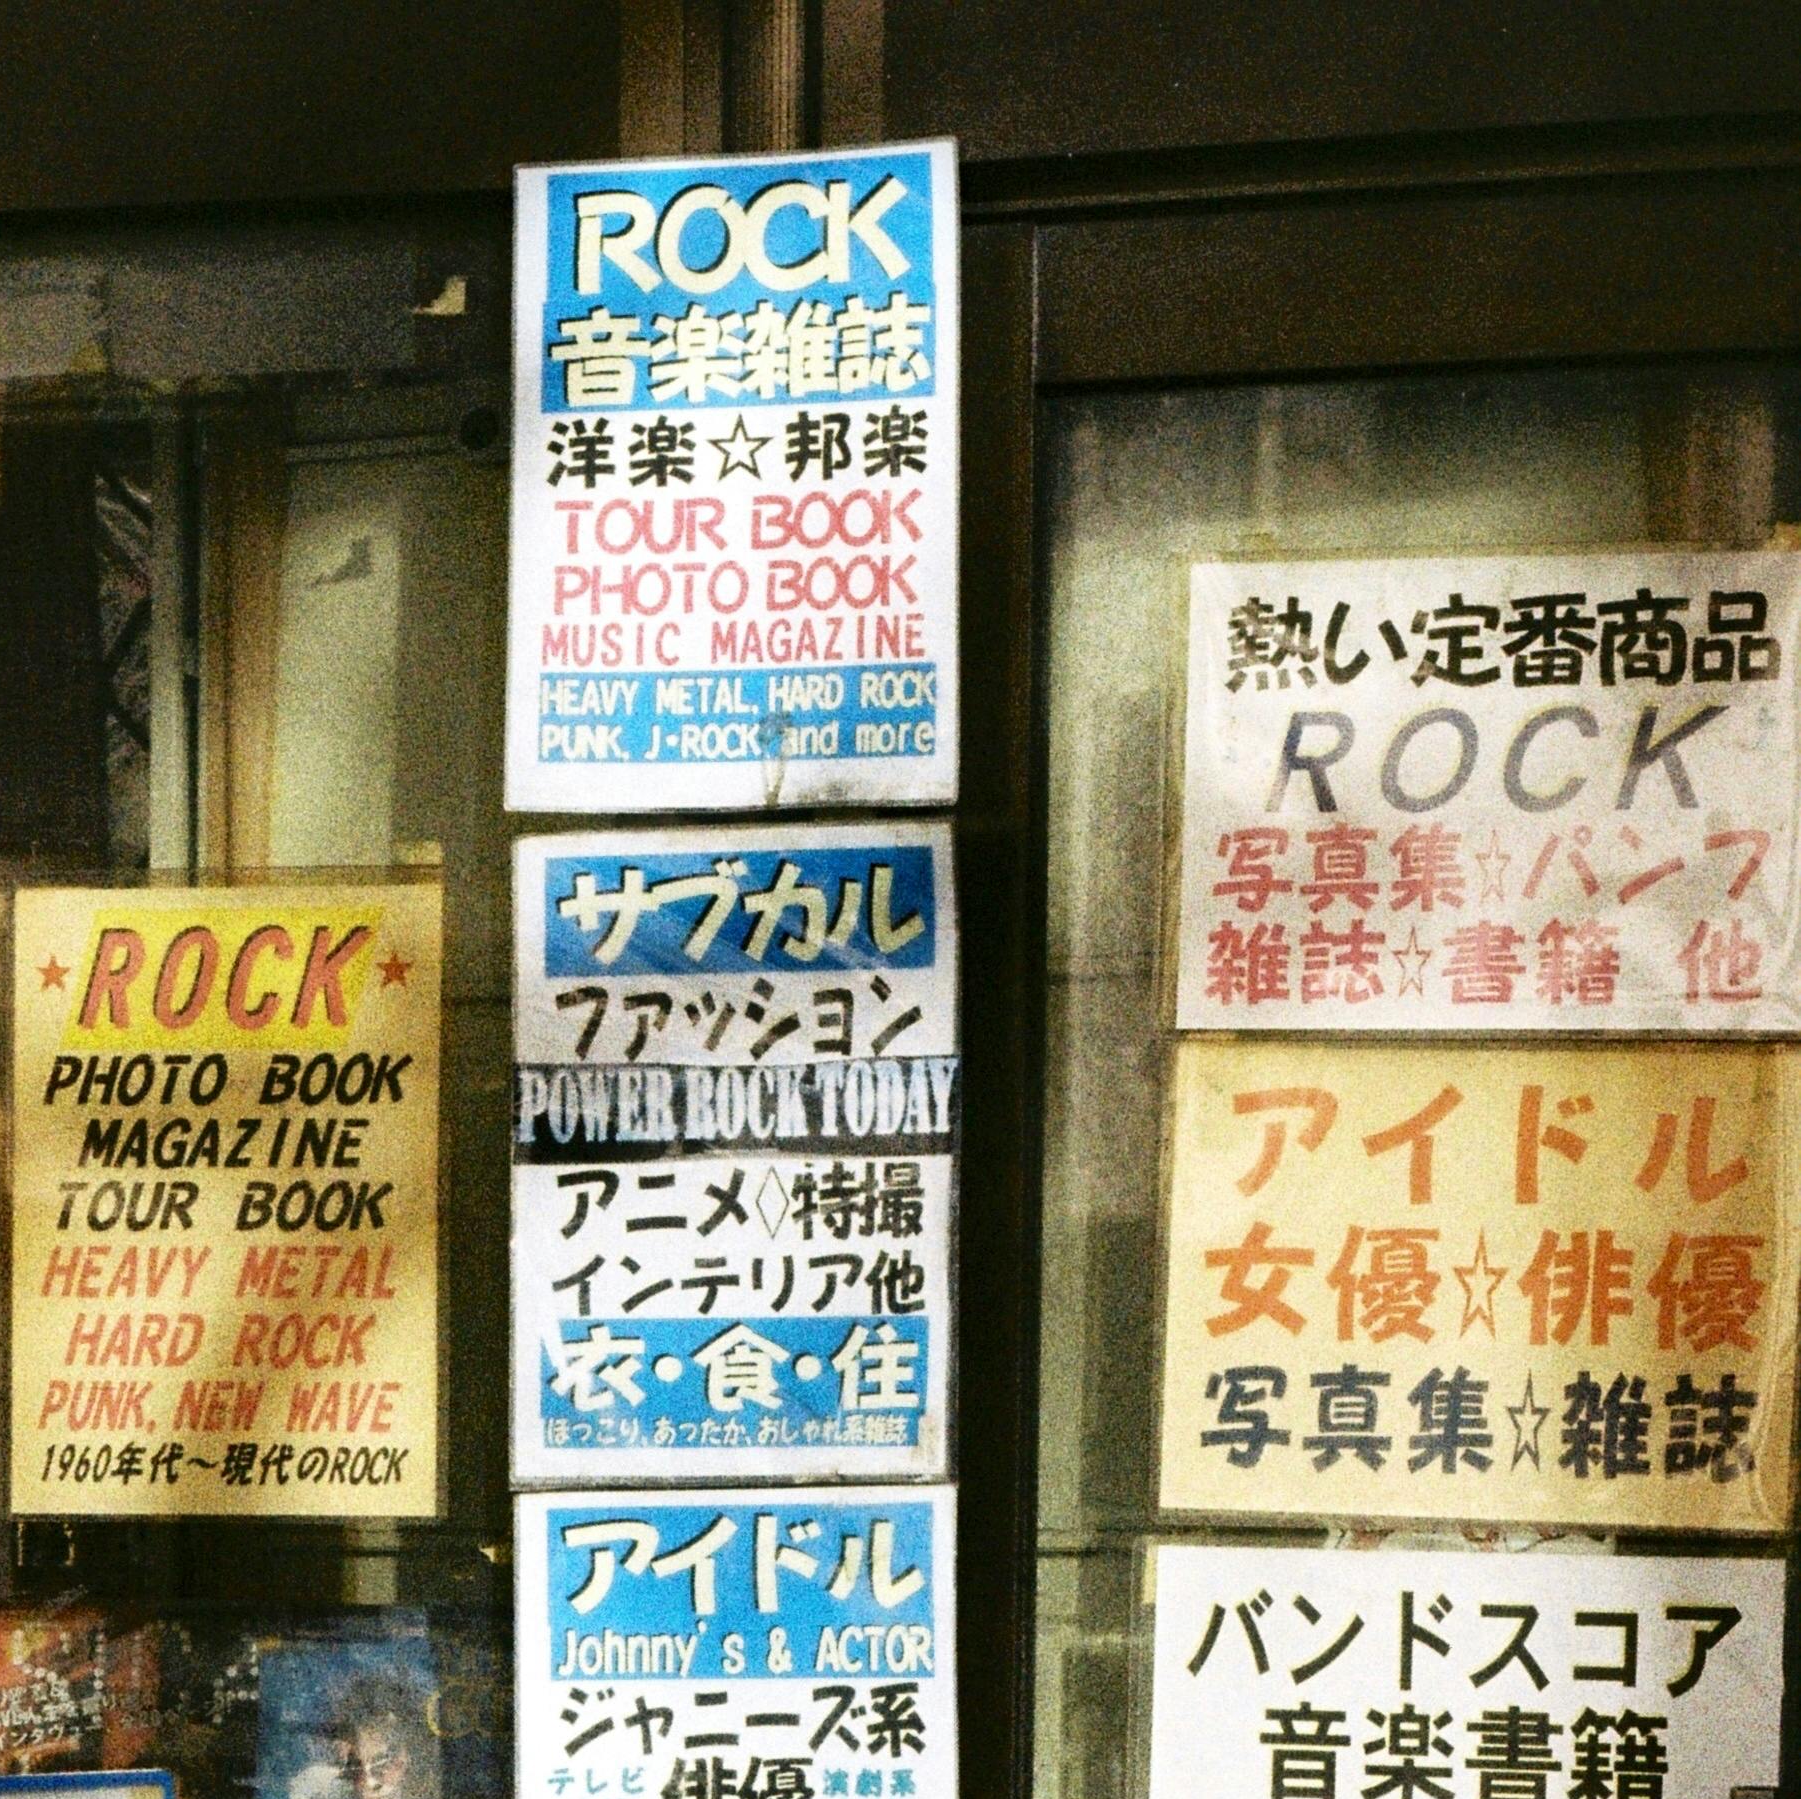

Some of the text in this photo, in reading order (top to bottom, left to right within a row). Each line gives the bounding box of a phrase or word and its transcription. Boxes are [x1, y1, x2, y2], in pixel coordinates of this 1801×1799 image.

[573, 172, 912, 296] ROCK
[549, 290, 932, 408] 音楽雑誌
[554, 488, 924, 555] TOUR BOOK
[553, 554, 919, 616] PHOTO BOOK
[542, 613, 925, 667] MUSIC MAGAZINE
[1224, 587, 1782, 694] 熱い定番商品
[541, 678, 636, 715] HEAVY
[767, 673, 844, 712] HARD
[859, 670, 937, 709] ROCK
[854, 724, 936, 758] more
[1264, 704, 1731, 815] ROCK
[557, 859, 927, 964] サブカル
[77, 923, 375, 1032] ROCK
[1676, 919, 1764, 1007] 他
[554, 974, 923, 1062] ファッション
[43, 1051, 413, 1107] PHOTO BOOK
[518, 1058, 959, 1145] POWER ROCK TODAY
[76, 1117, 371, 1169] MAGAZINE
[1231, 1083, 1751, 1205] アイドル
[55, 1179, 396, 1233] TOUR BOOK
[40, 1243, 398, 1300] HEAVY METAL
[552, 1249, 926, 1316] インテリア他
[63, 1312, 377, 1368] HARD ROCK
[549, 1321, 921, 1413] 衣・食・住
[173, 1379, 268, 1432] NEW
[285, 1379, 402, 1433] WAVE
[560, 1512, 926, 1617] アイドル
[767, 1624, 794, 1674] &
[1186, 1588, 1743, 1699] バンドスコア
[558, 1680, 927, 1759] ジャニーズ系
[547, 1766, 646, 1798] テレビ
[821, 1767, 917, 1799] 演劇系
